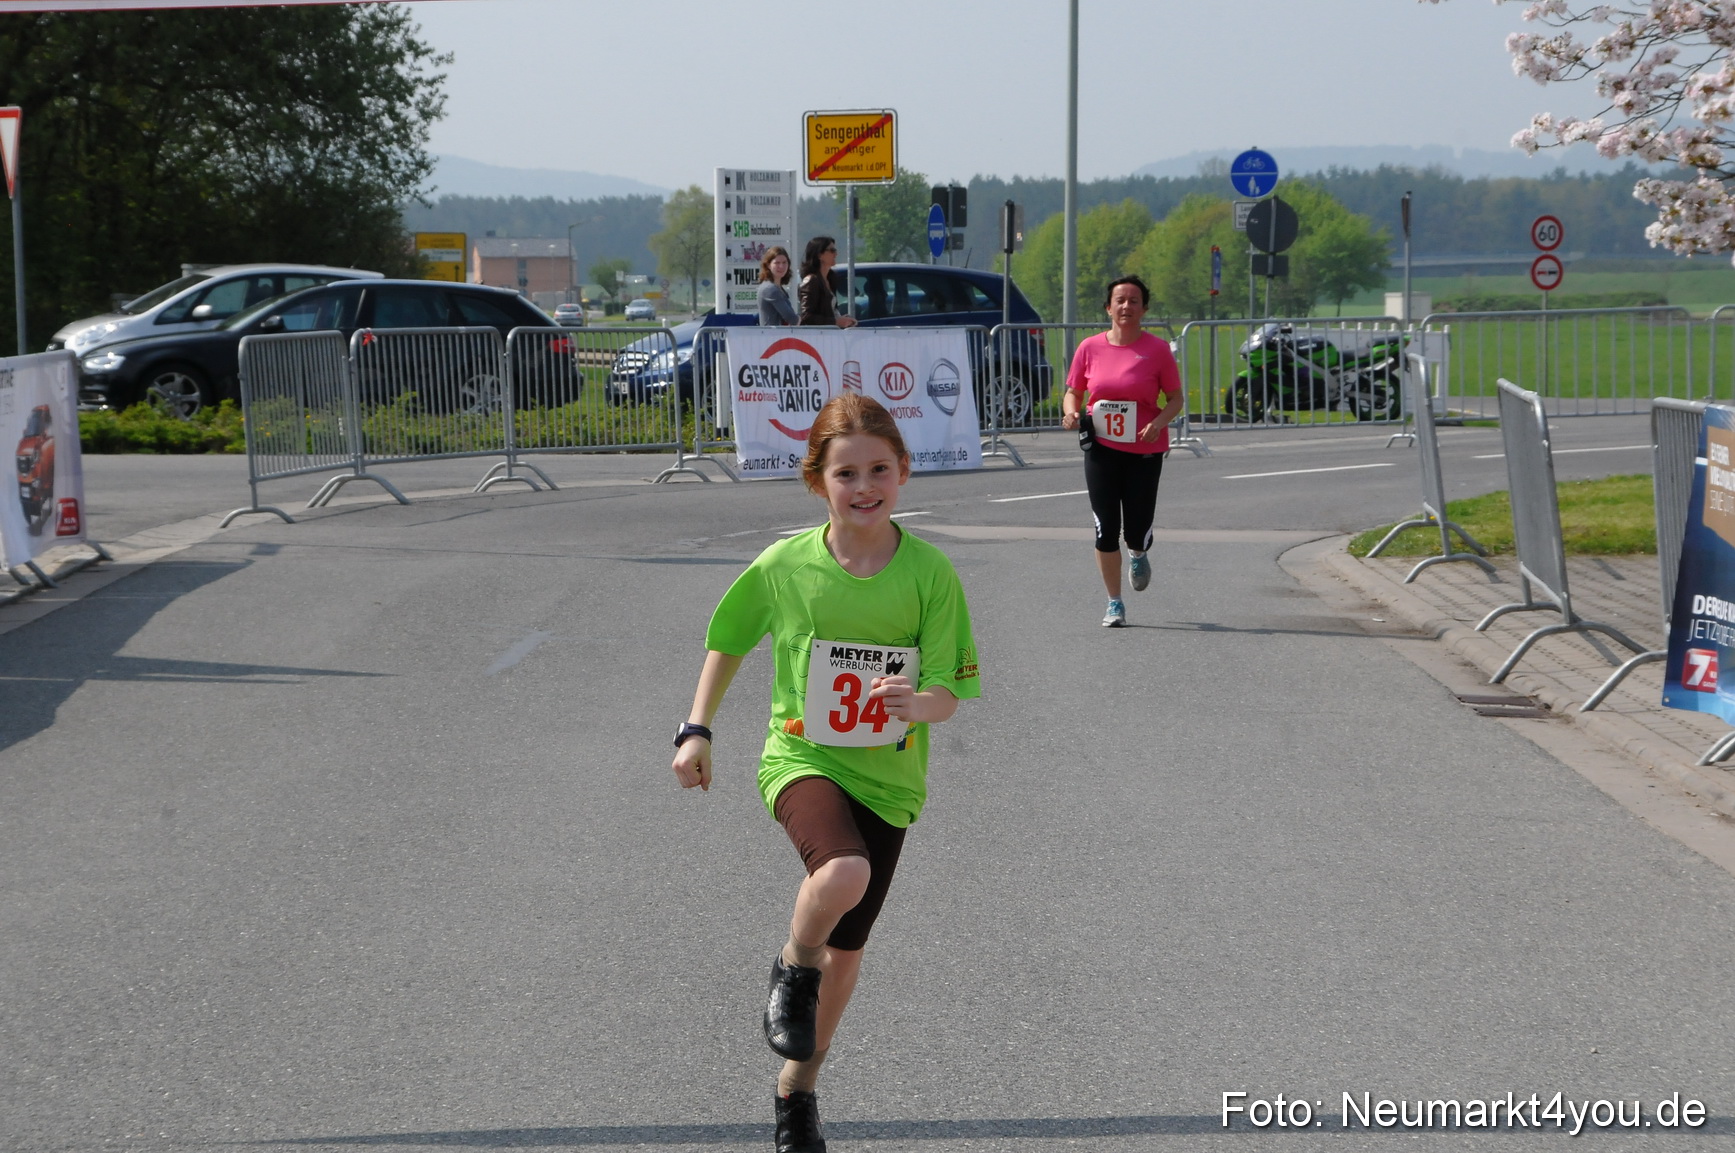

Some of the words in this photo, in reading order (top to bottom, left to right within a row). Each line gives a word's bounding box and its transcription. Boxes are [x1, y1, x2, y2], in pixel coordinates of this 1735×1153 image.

[815, 122, 885, 143] Sengenthal
[824, 146, 840, 154] am
[845, 144, 876, 156] Anger
[832, 162, 864, 172] Neumarkt
[733, 220, 749, 237] SHB
[1538, 225, 1556, 241] 60
[738, 364, 811, 388] GERHART
[813, 370, 819, 382] &
[884, 372, 908, 391] KIA
[738, 390, 778, 402] Autohaus
[778, 389, 822, 413] JÄNIG
[890, 406, 923, 419] MOTORS
[1104, 413, 1125, 437] 13
[743, 454, 780, 471] eumarkt
[829, 646, 883, 662] MEYER
[829, 658, 883, 672] WERBUNG
[1686, 653, 1712, 686] 7
[828, 673, 890, 734] 34
